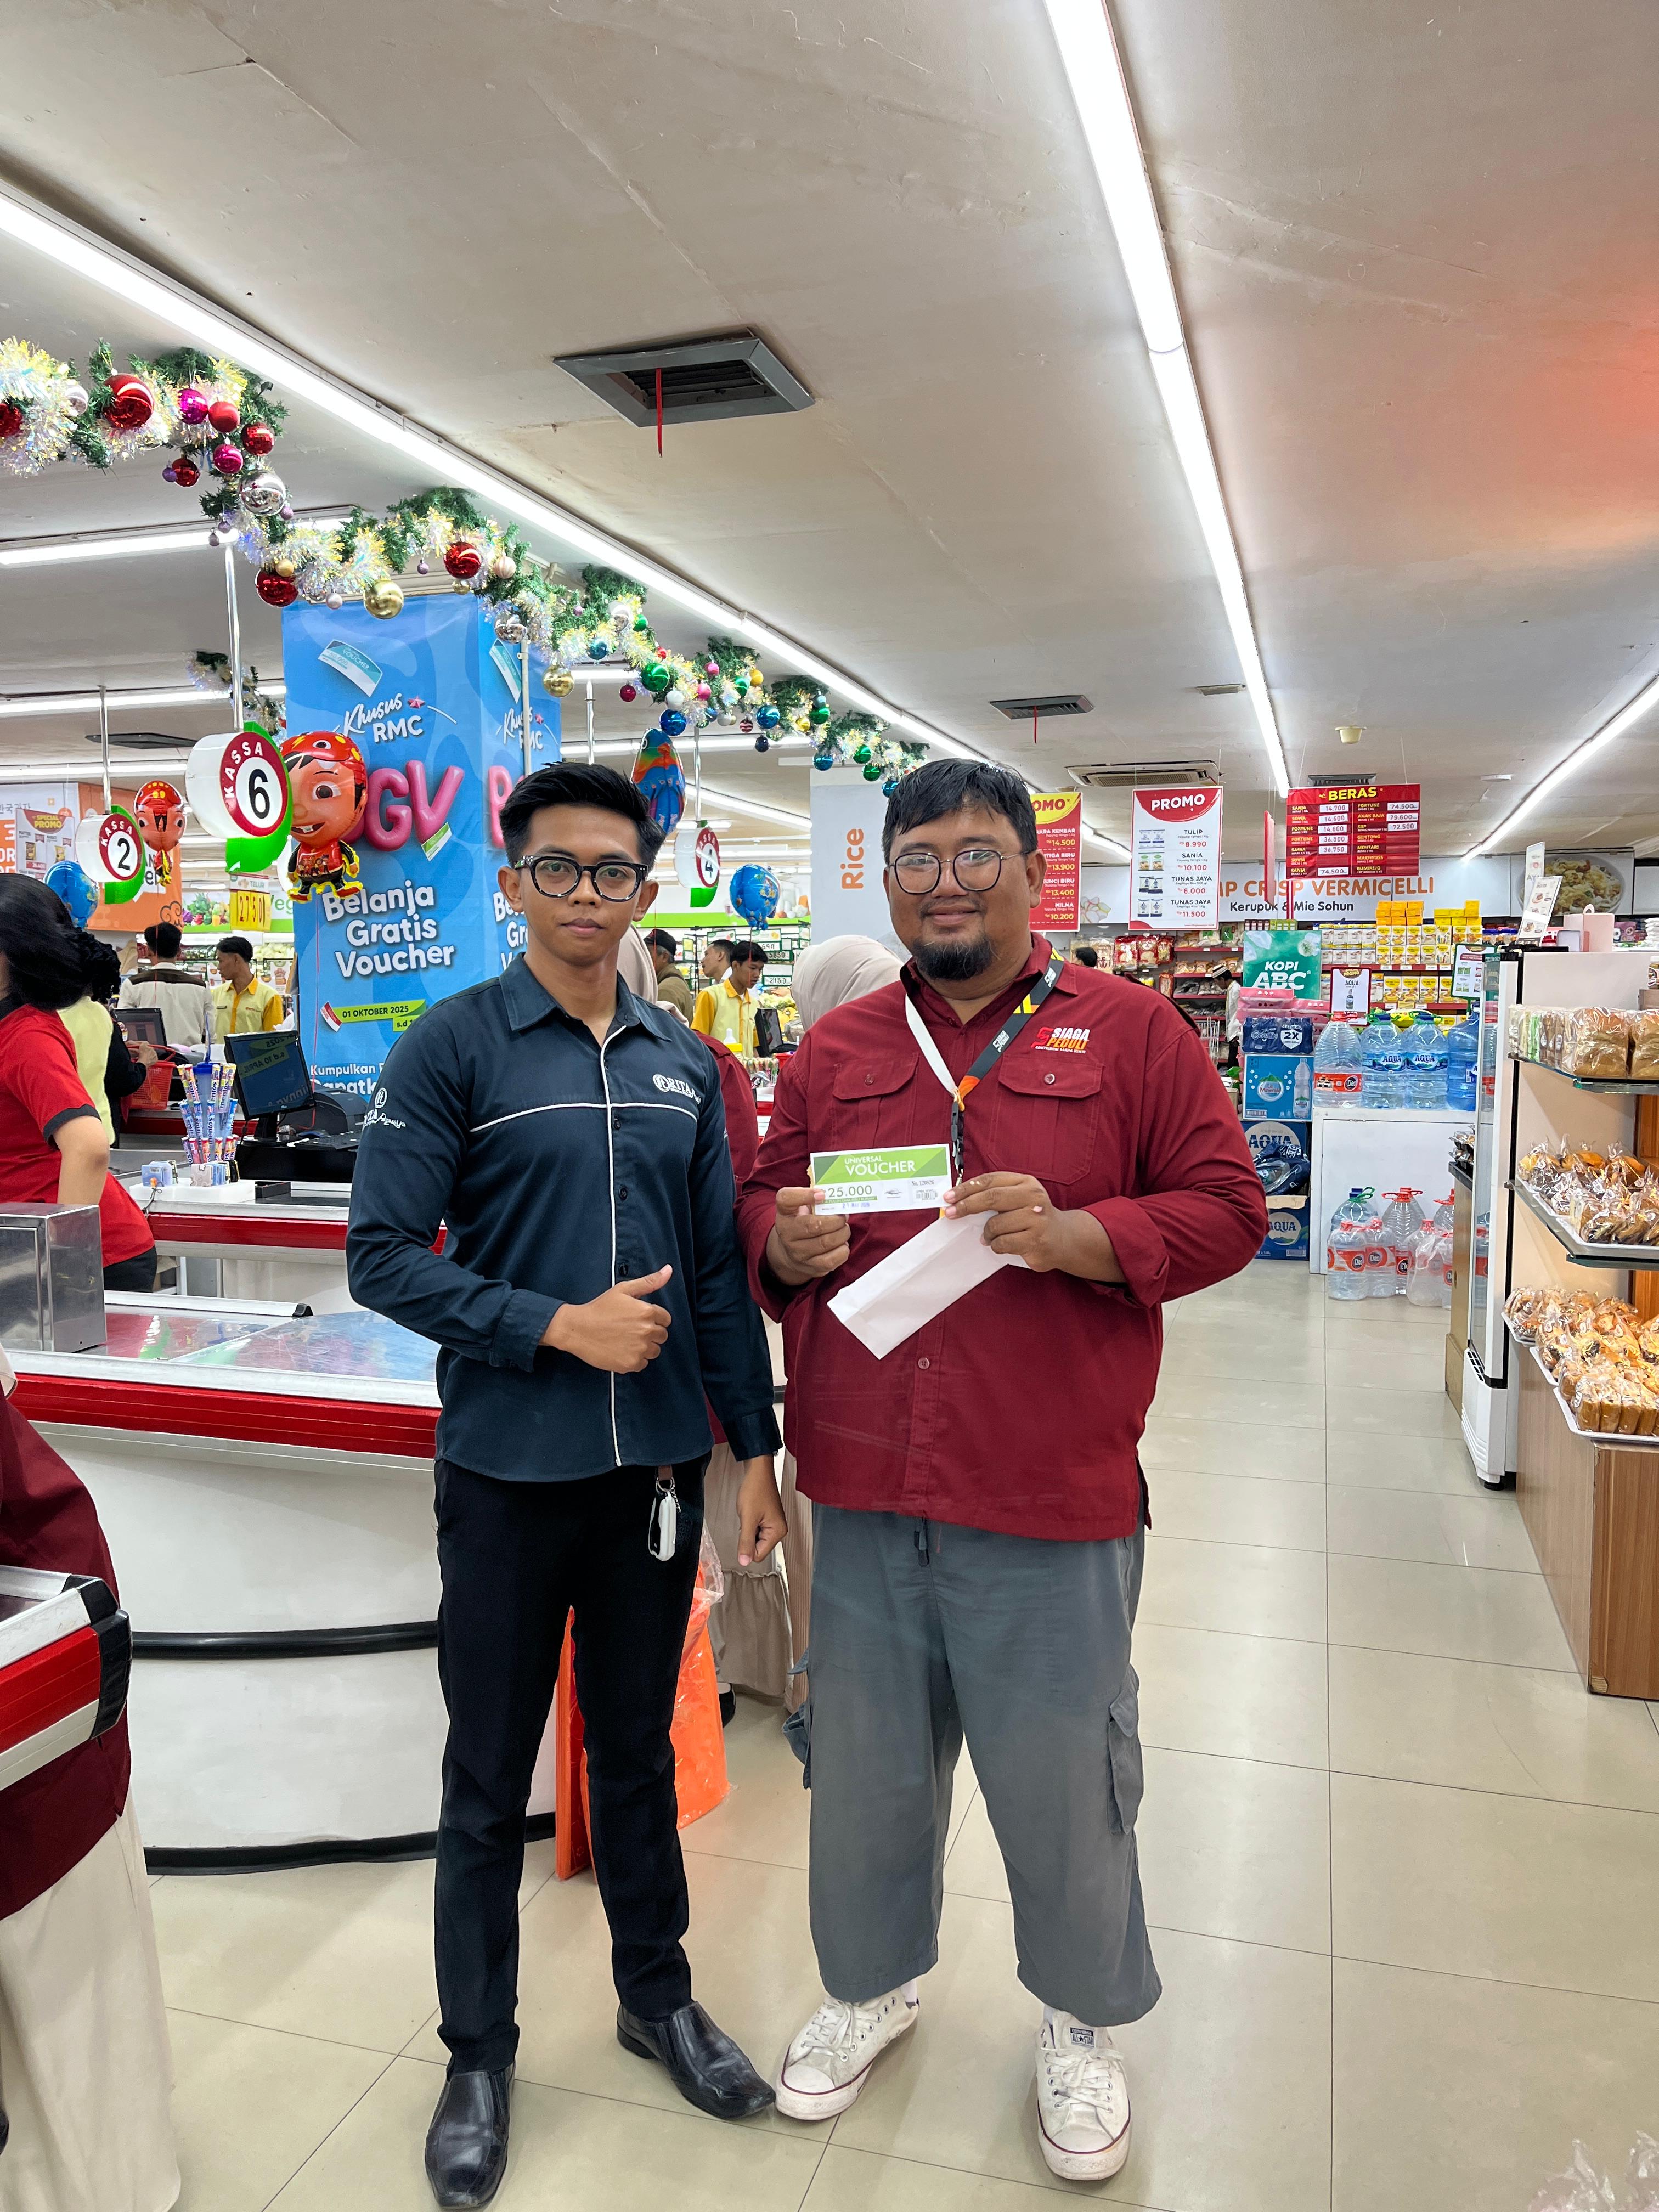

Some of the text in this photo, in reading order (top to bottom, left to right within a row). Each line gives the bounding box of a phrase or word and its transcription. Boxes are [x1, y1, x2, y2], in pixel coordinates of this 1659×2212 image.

[342, 693, 403, 736] Khusus
[373, 715, 424, 743] RMC
[223, 741, 263, 799] KASSA
[248, 769, 270, 819] 6
[1152, 793, 1206, 811] PROMO
[1328, 787, 1378, 801] BERAS
[341, 760, 465, 851] GV
[34, 820, 62, 828] PROMO
[100, 820, 133, 847] KASSA
[117, 838, 131, 871] 2
[840, 828, 865, 890] Rice
[1312, 877, 1434, 896] VERMICELLI
[322, 879, 435, 923] Belanja
[1230, 901, 1278, 913] Kerupuk
[1294, 901, 1316, 911] Mie
[1318, 900, 1354, 911] Sohun
[346, 914, 437, 947] Gratis
[335, 943, 455, 978] Voucher
[1265, 961, 1299, 971] KOPI
[1251, 971, 1307, 990] ABC
[353, 1007, 388, 1017] OKTOBER
[390, 1005, 409, 1014] 2025
[396, 1019, 408, 1028] s.d
[1051, 1027, 1090, 1041] SIAGA
[1284, 1031, 1300, 1041] 2X
[1046, 1037, 1088, 1050] PEDULI
[1382, 1054, 1402, 1063] AQUA
[1414, 1054, 1436, 1063] AQUA
[311, 1063, 376, 1077] Kumpulkan
[219, 1080, 229, 1109] mentos
[844, 1155, 883, 1164] UNIVERSAL
[845, 1160, 916, 1176] VOUCHER
[828, 1185, 872, 1198] 25.000
